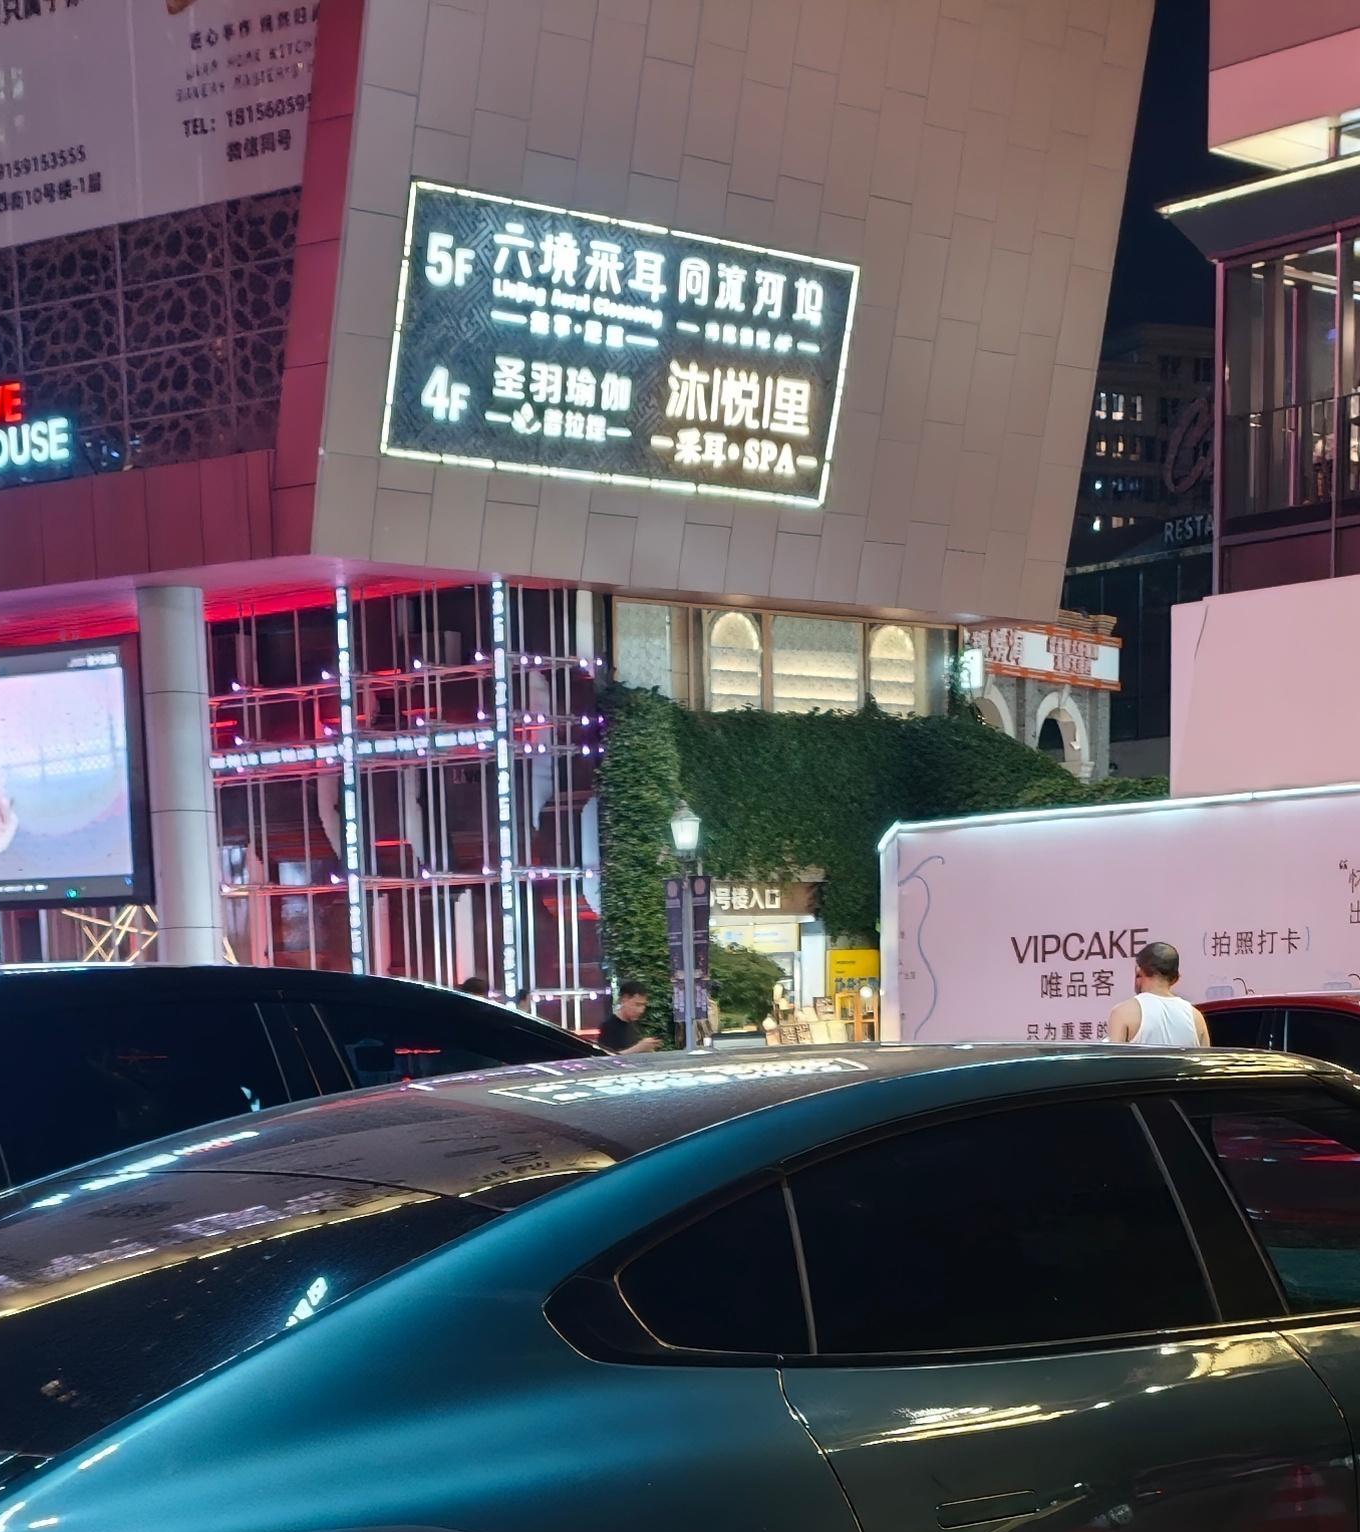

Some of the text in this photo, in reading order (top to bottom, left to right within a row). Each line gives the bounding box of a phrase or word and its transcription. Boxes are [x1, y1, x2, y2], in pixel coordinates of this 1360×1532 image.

[424, 231, 476, 288] 5F
[492, 222, 668, 303] 六境采耳
[420, 365, 471, 423] 4F
[492, 355, 632, 411] 圣羽瑜伽
[1011, 927, 1149, 965] VIPCAKE
[1040, 969, 1116, 999] 唯品客
